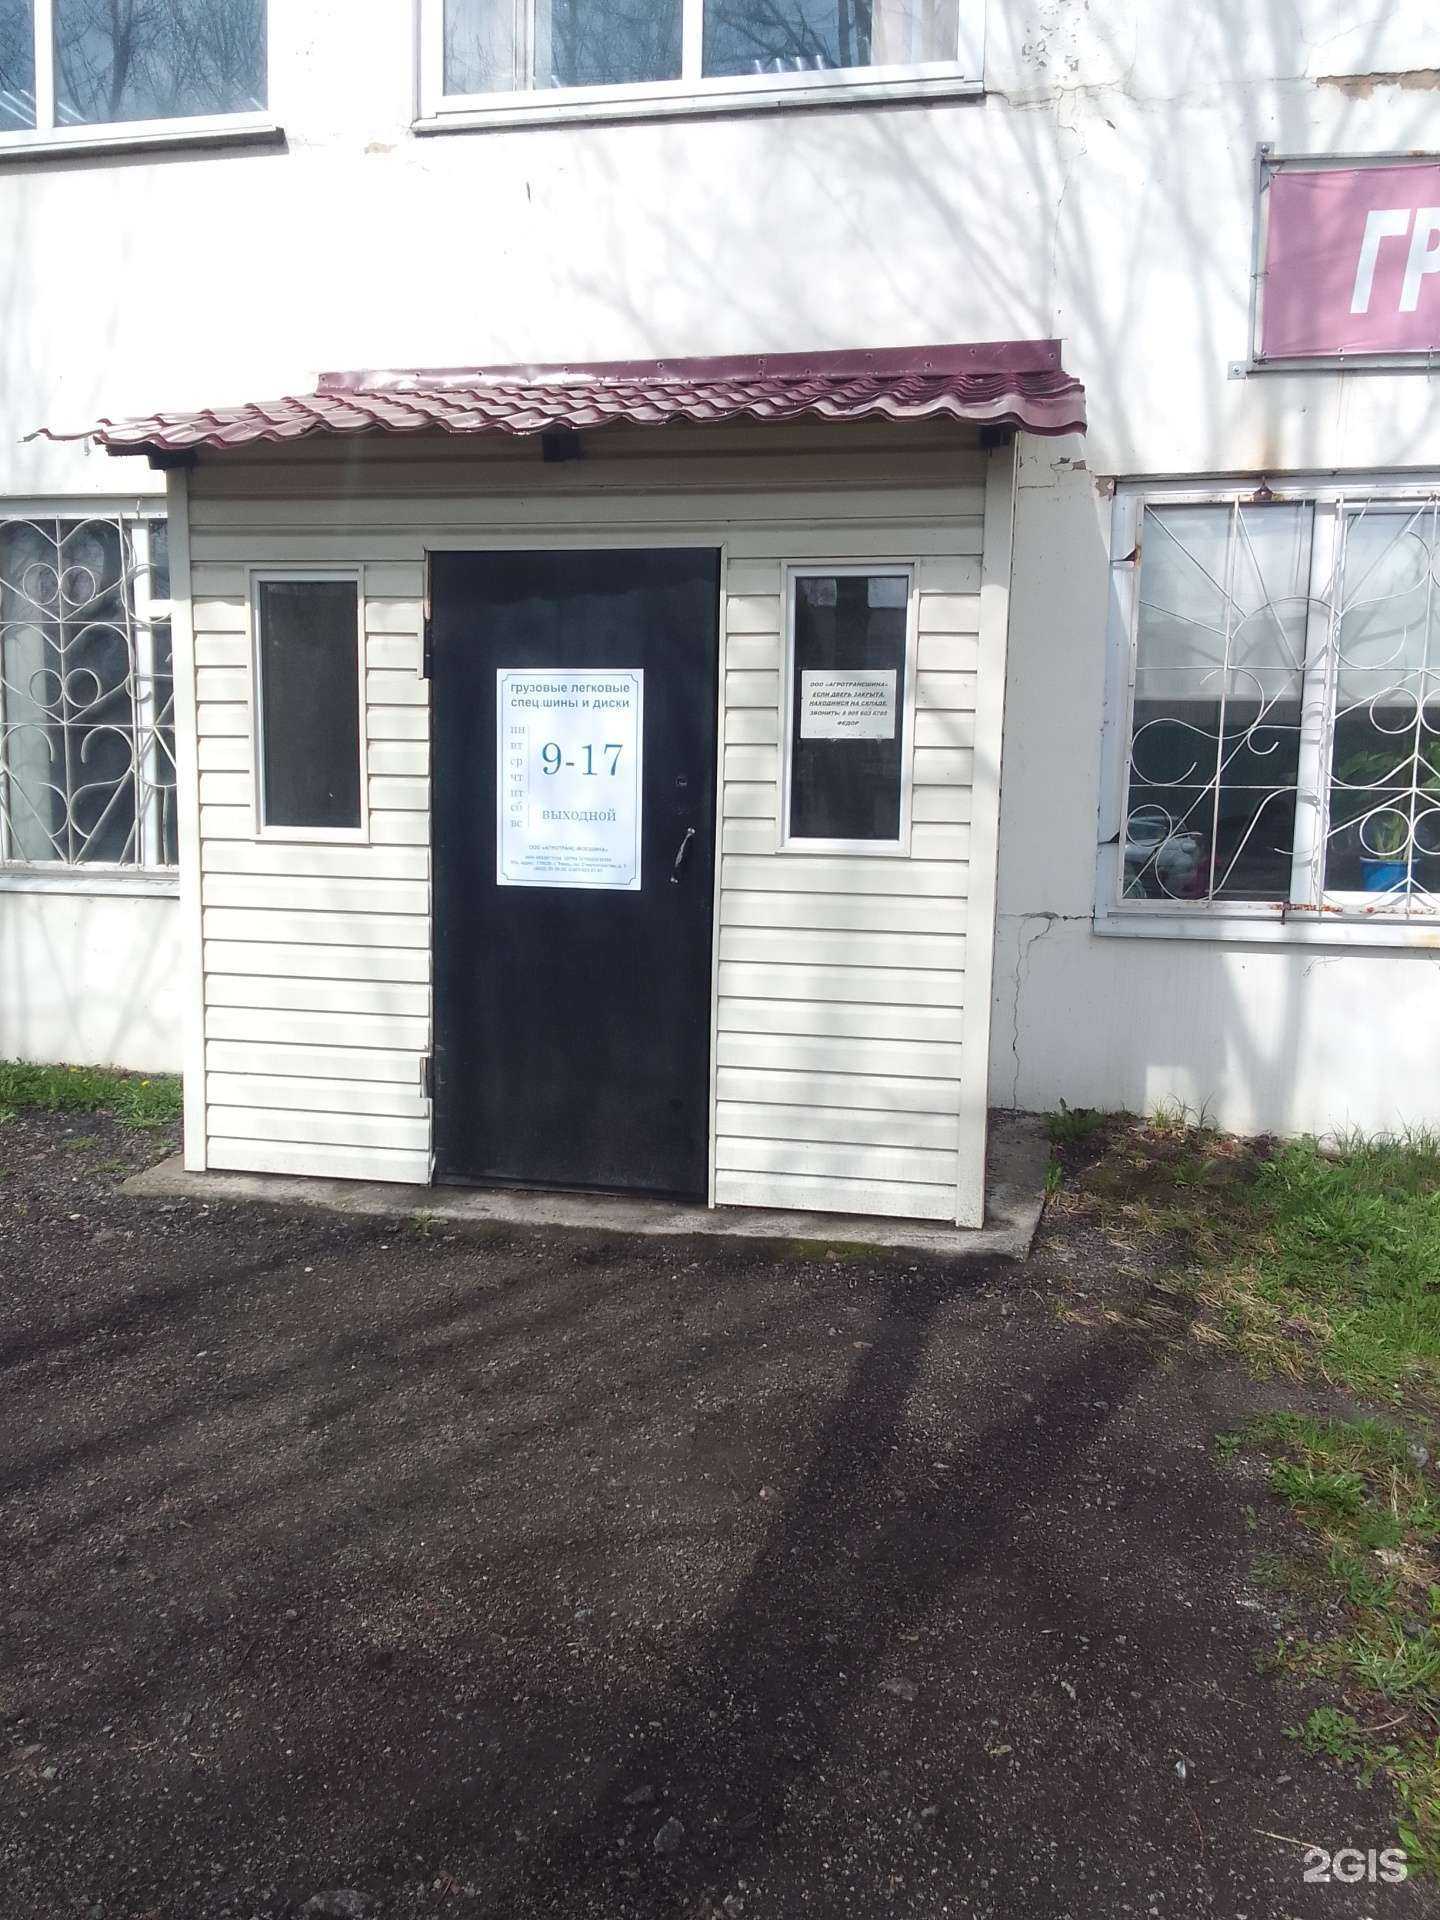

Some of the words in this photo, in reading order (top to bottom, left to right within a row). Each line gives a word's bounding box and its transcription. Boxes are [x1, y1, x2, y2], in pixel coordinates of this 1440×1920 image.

[510, 683, 568, 694] грузовые
[571, 684, 630, 693] легковые
[581, 699, 590, 707] и
[592, 699, 630, 709] диски
[510, 726, 526, 734] пн
[510, 758, 523, 768] ср
[541, 742, 623, 776] 9-17
[510, 773, 524, 782] чт
[542, 808, 617, 822] выходной
[510, 819, 523, 828] вс
